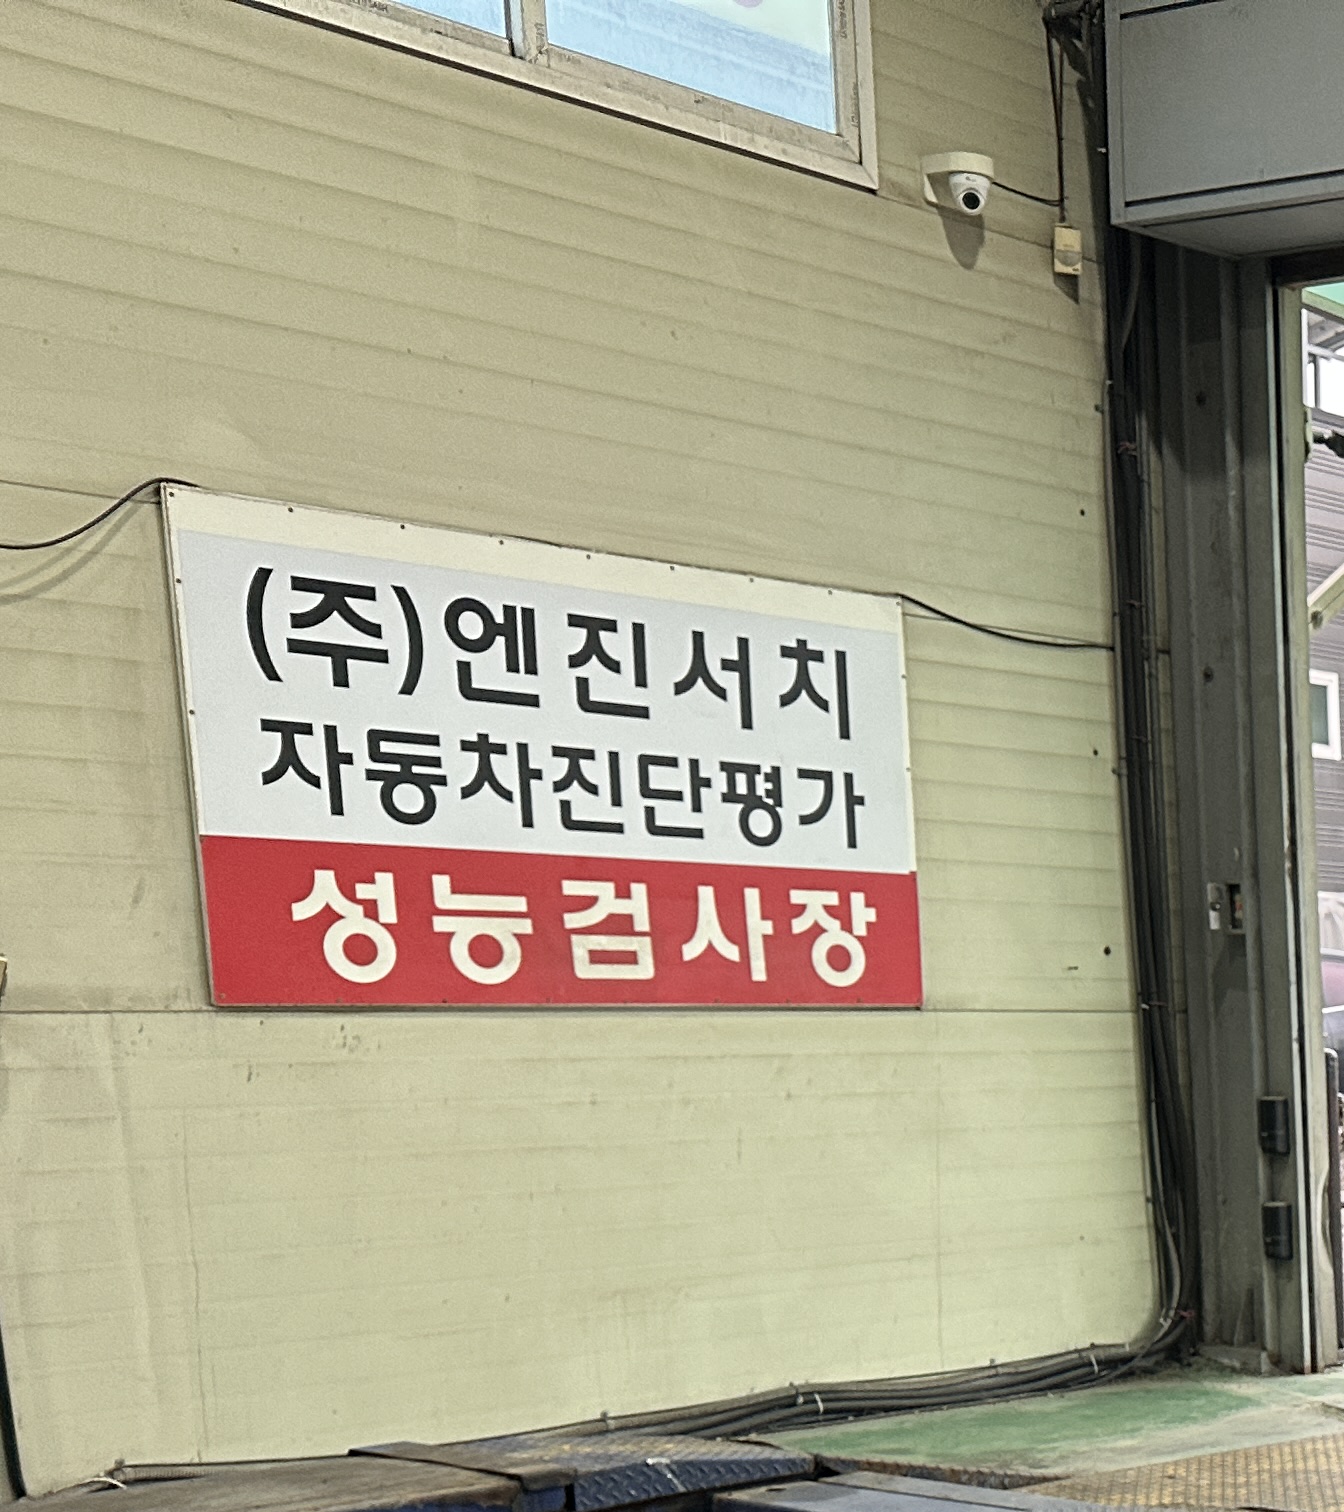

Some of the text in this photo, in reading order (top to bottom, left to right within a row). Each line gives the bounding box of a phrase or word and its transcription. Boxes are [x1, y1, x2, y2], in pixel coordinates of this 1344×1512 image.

[246, 567, 851, 740] (주)엔진서치
[260, 717, 865, 849] 자동차진단평가
[291, 868, 877, 988] 성능검사장
